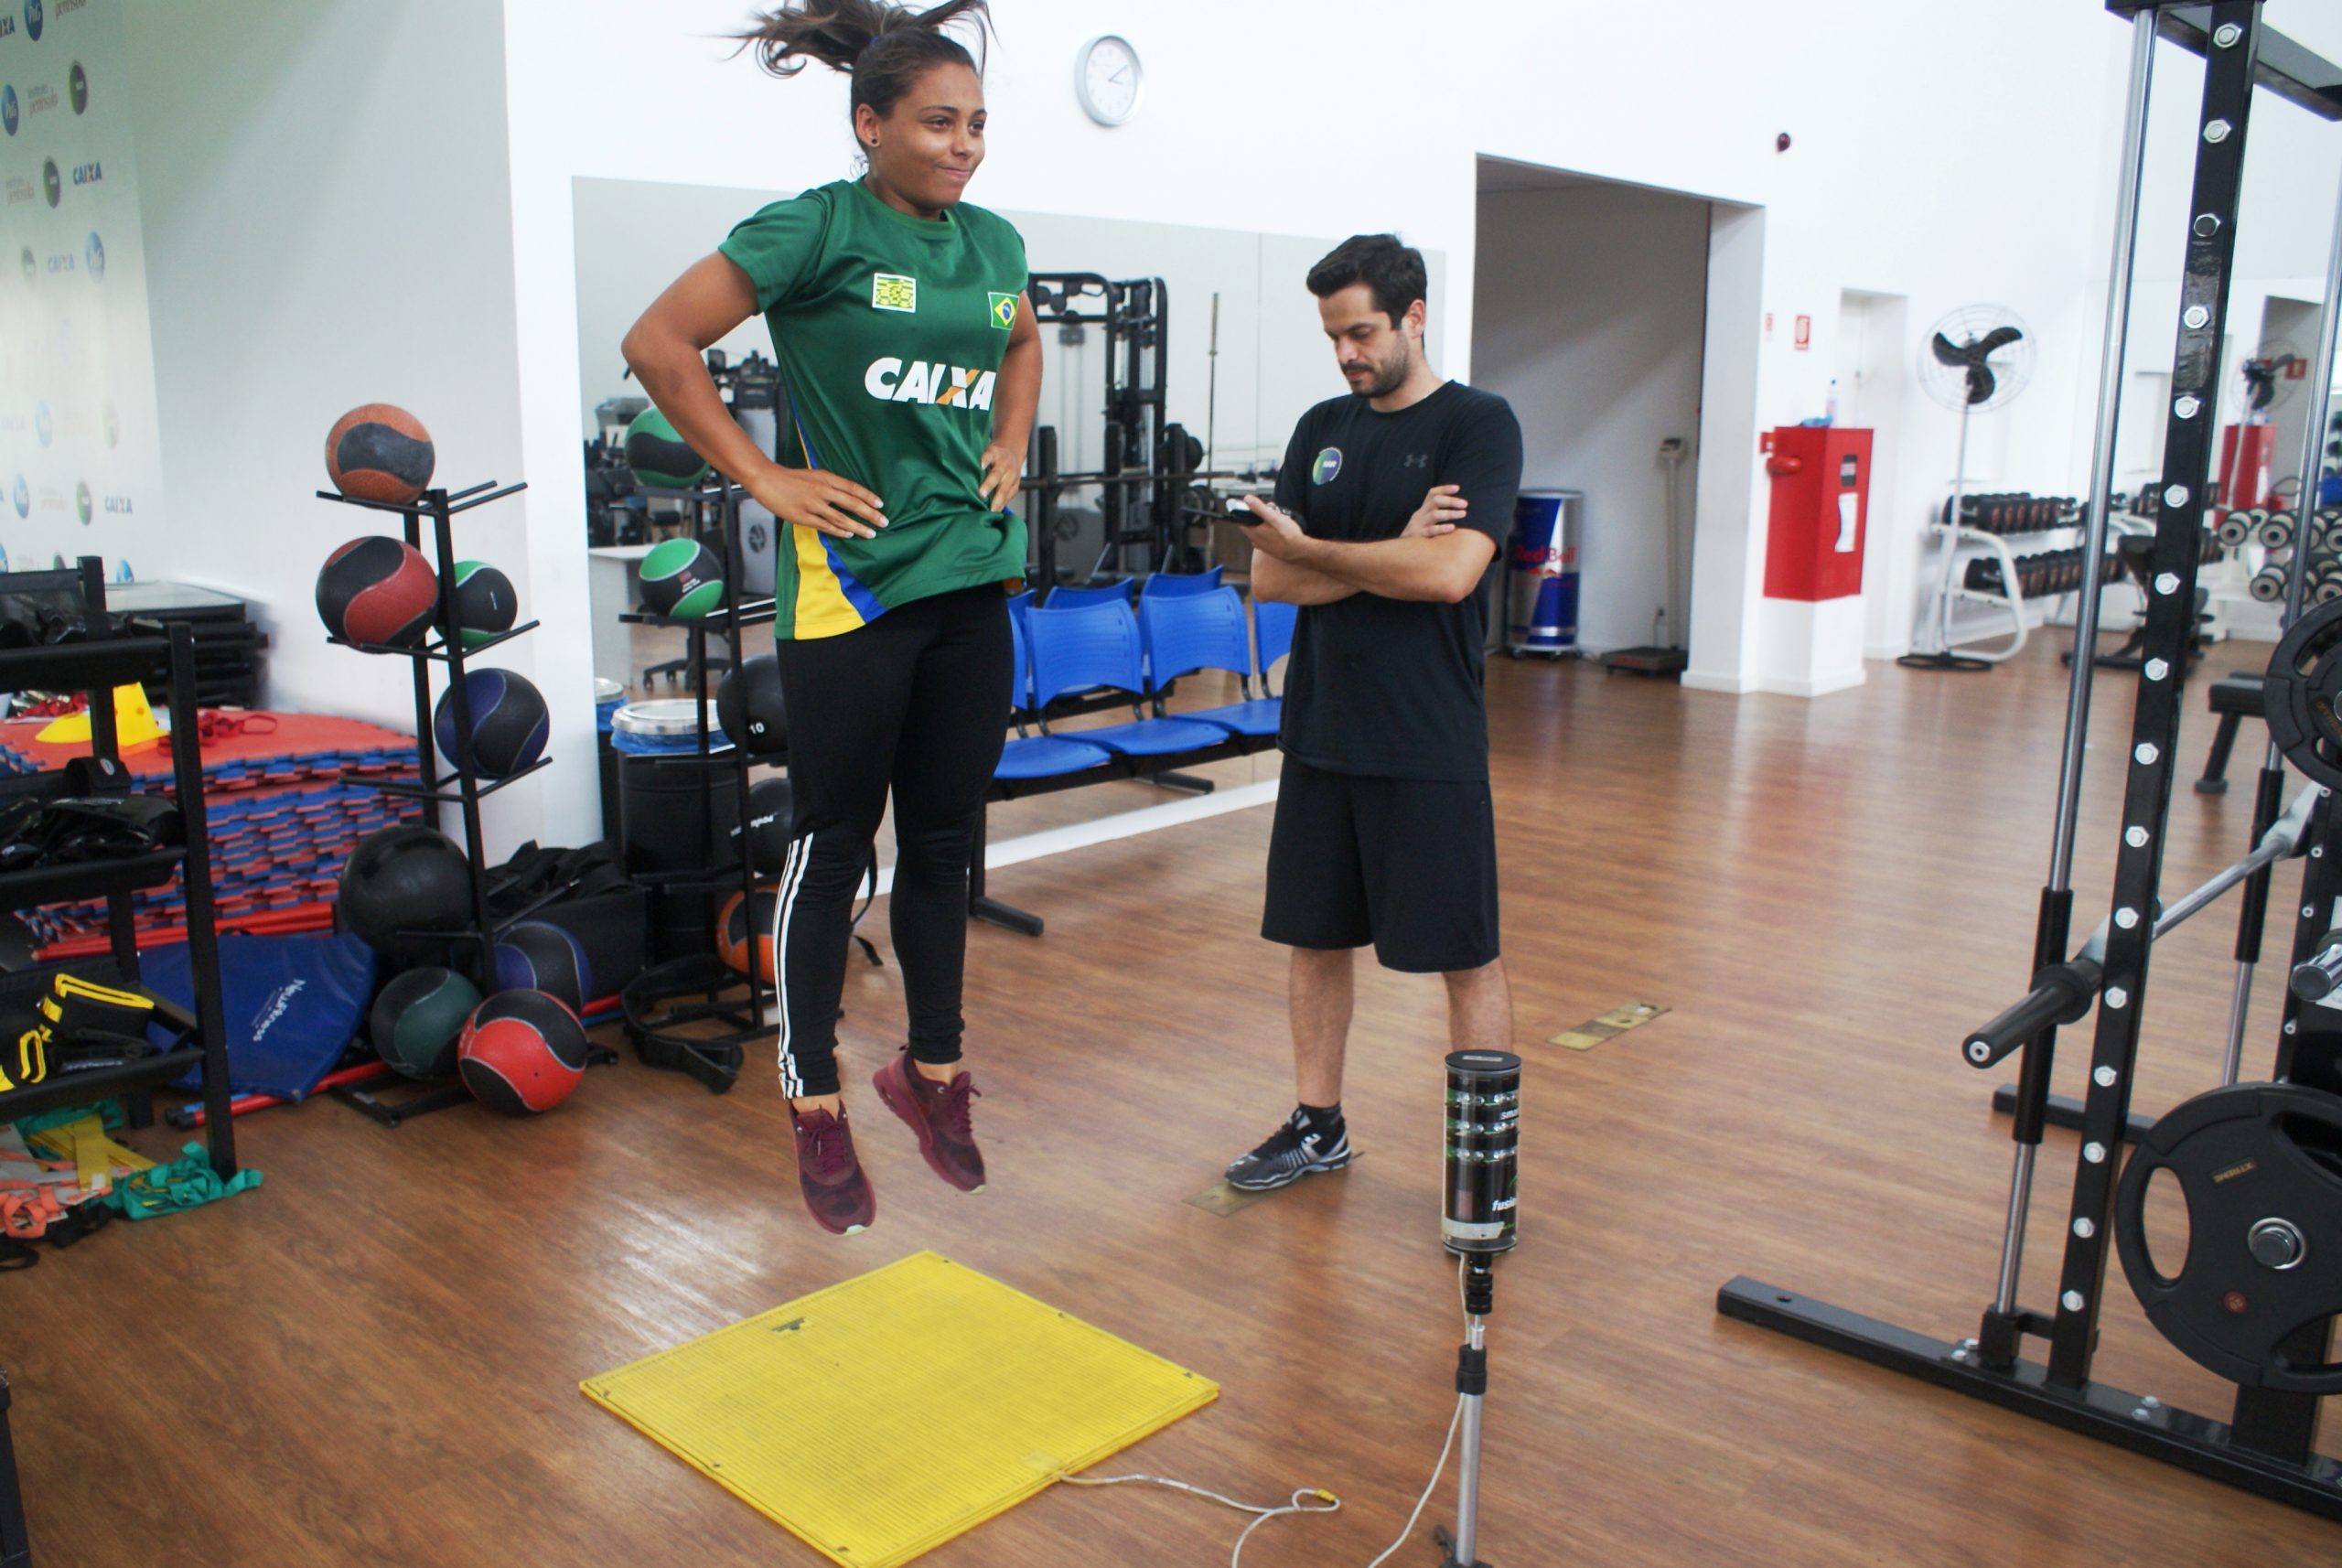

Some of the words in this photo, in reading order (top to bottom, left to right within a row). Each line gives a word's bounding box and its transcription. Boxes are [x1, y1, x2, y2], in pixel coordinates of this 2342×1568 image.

[72, 161, 102, 186] CAIXA
[865, 357, 996, 411] CAIXA
[104, 496, 134, 514] CAIXA
[749, 722, 765, 735] 10
